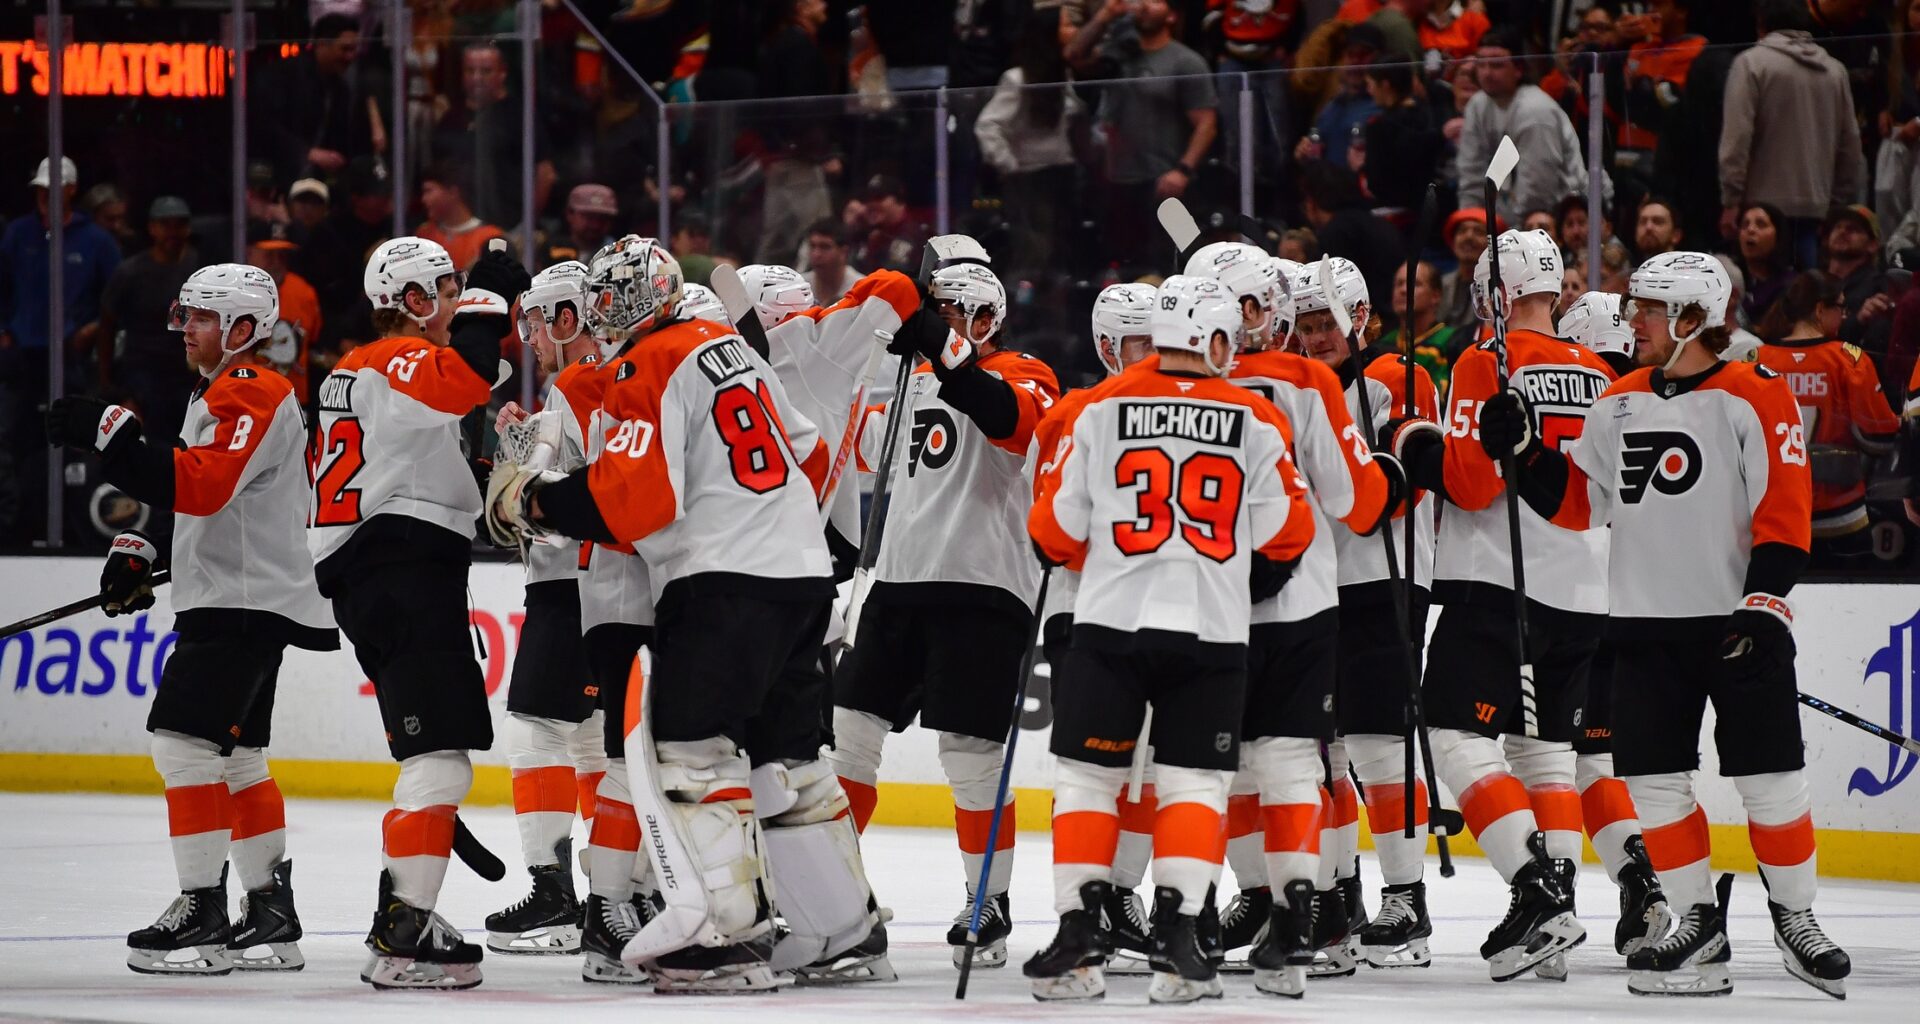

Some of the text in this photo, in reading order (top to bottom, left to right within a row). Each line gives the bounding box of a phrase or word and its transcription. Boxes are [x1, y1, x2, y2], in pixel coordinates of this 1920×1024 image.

[1540, 257, 1555, 272] 55
[1612, 313, 1621, 327] 9
[227, 414, 254, 451] 8
[606, 418, 654, 459] 80
[1126, 405, 1236, 443] MICHKOV
[1775, 422, 1807, 467] 29
[1112, 445, 1245, 564] 39
[646, 814, 679, 890] SUPREME
[234, 927, 257, 942] BAUER
